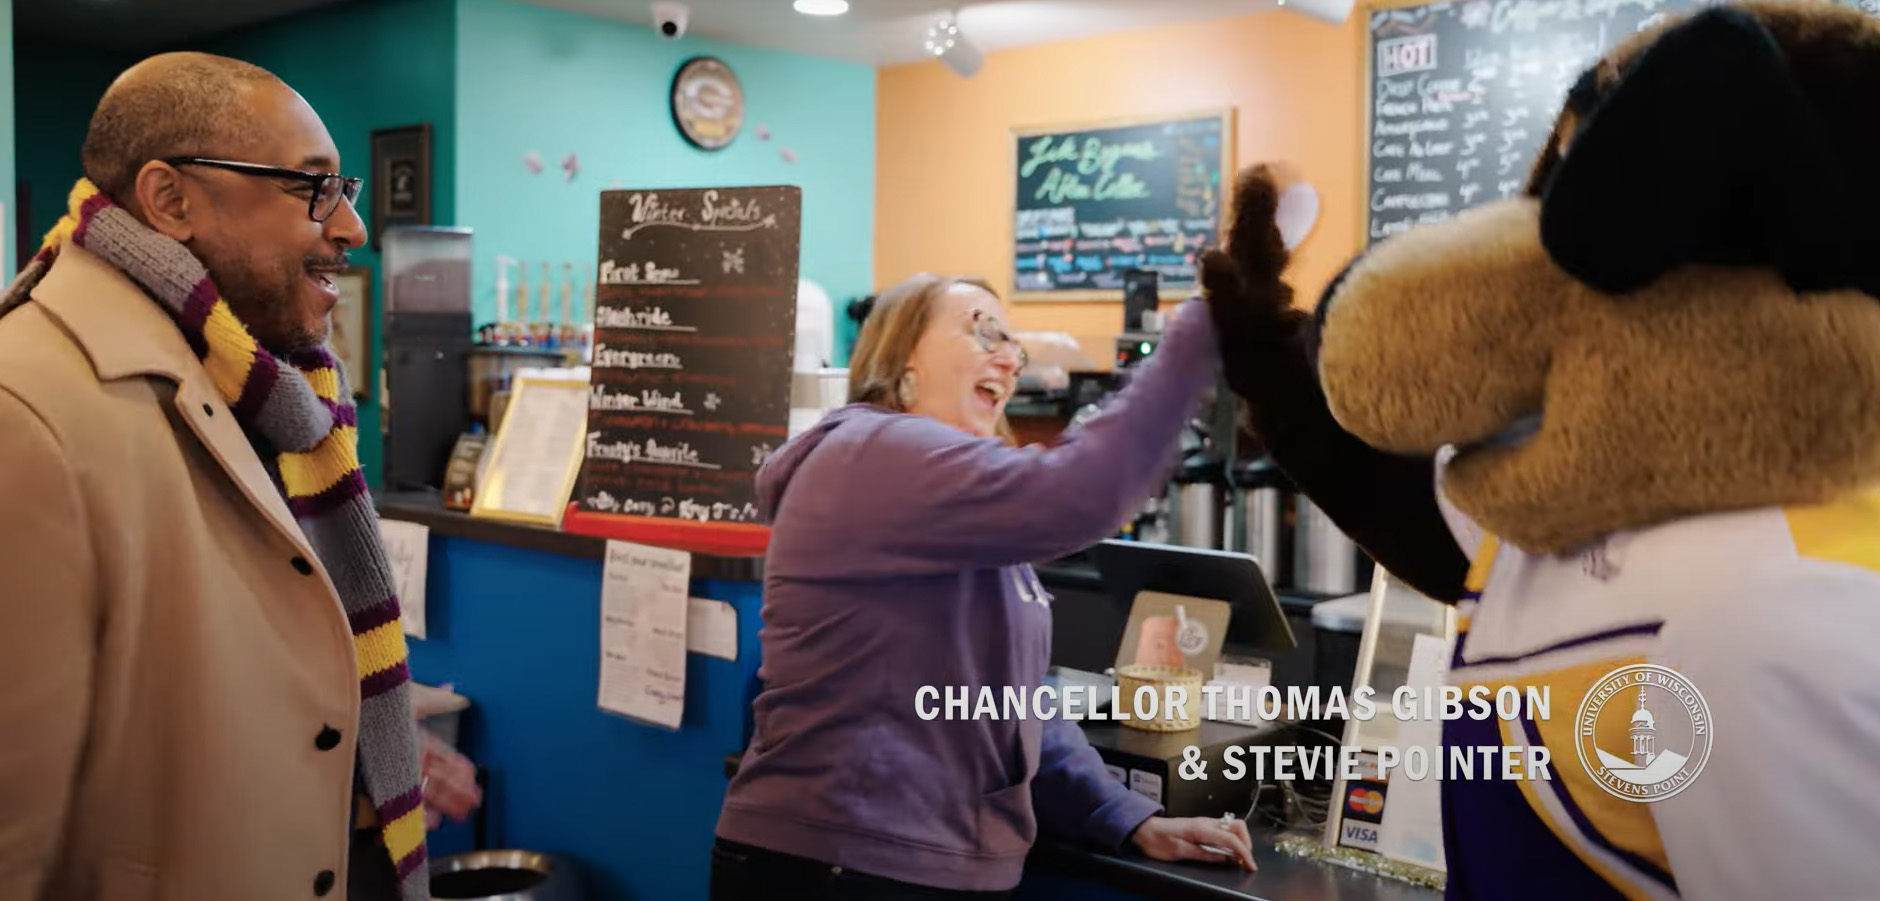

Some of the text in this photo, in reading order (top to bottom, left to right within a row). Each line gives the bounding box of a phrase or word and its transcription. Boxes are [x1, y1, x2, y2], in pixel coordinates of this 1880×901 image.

[1384, 42, 1430, 71] HOT
[629, 190, 762, 227] Winter Specials
[590, 384, 684, 409] Winter Wind
[1346, 825, 1377, 843] VISA
